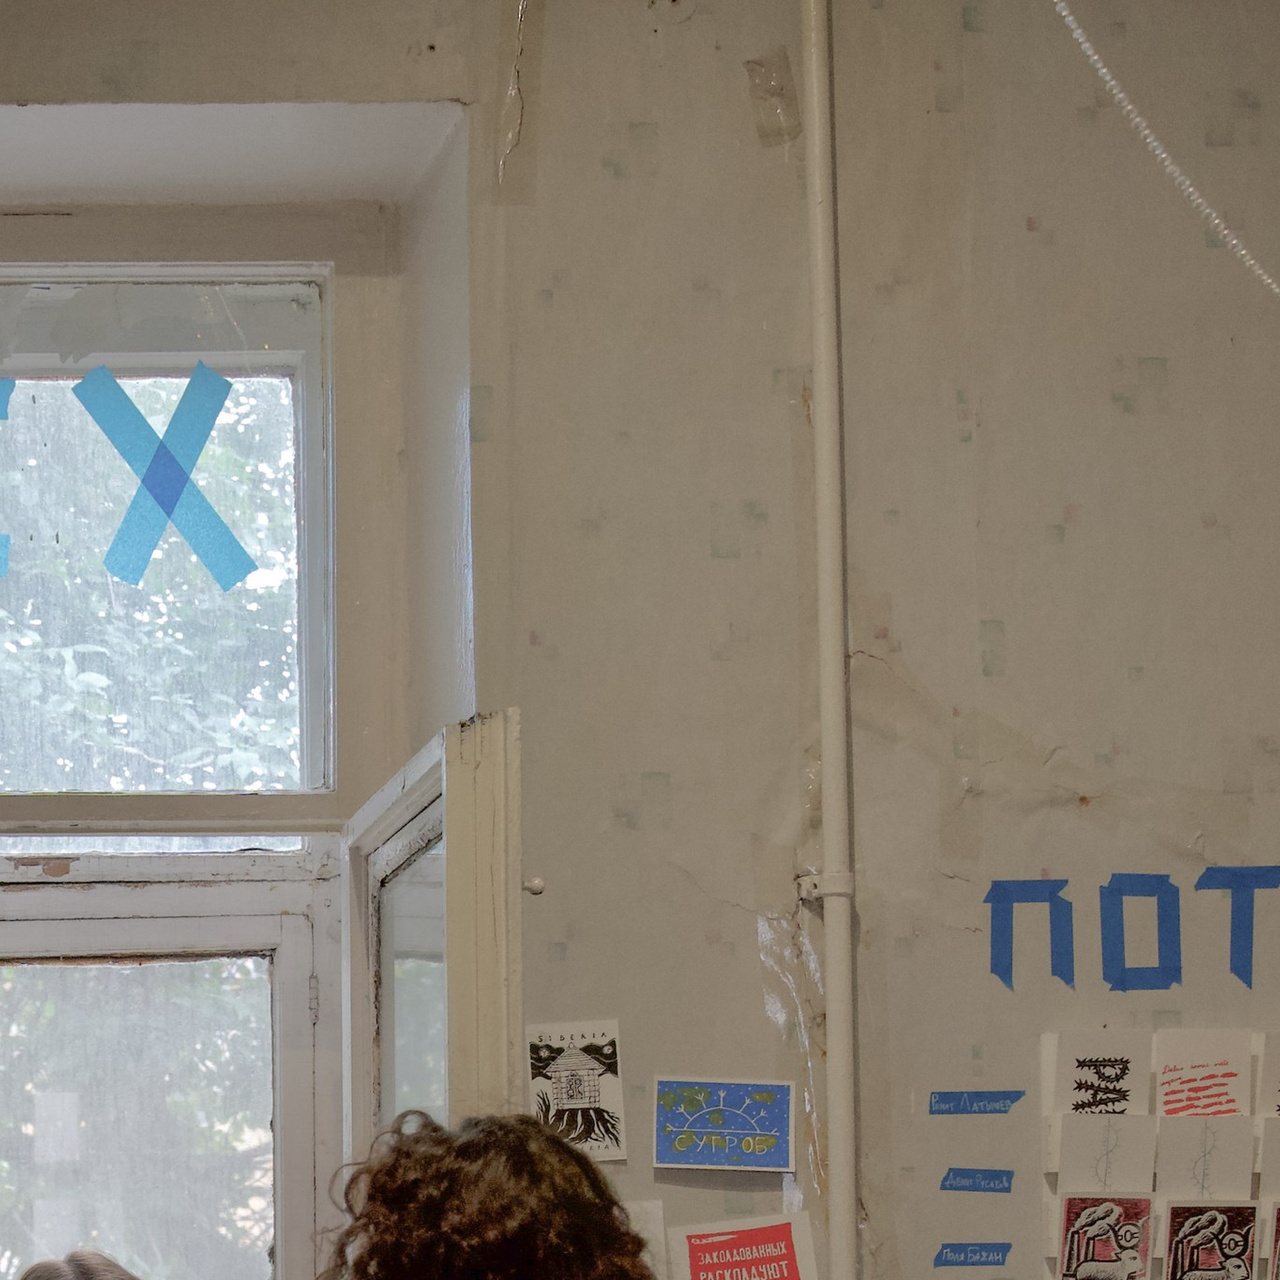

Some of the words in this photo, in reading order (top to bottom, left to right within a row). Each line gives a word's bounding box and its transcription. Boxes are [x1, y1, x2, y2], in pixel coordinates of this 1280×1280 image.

[538, 1031, 607, 1043] SIBERIA
[1071, 1056, 1132, 1114] РА
[674, 1134, 768, 1156] СУГРОБ
[697, 1240, 788, 1266] ЗАКОЛДОВАННЫХ
